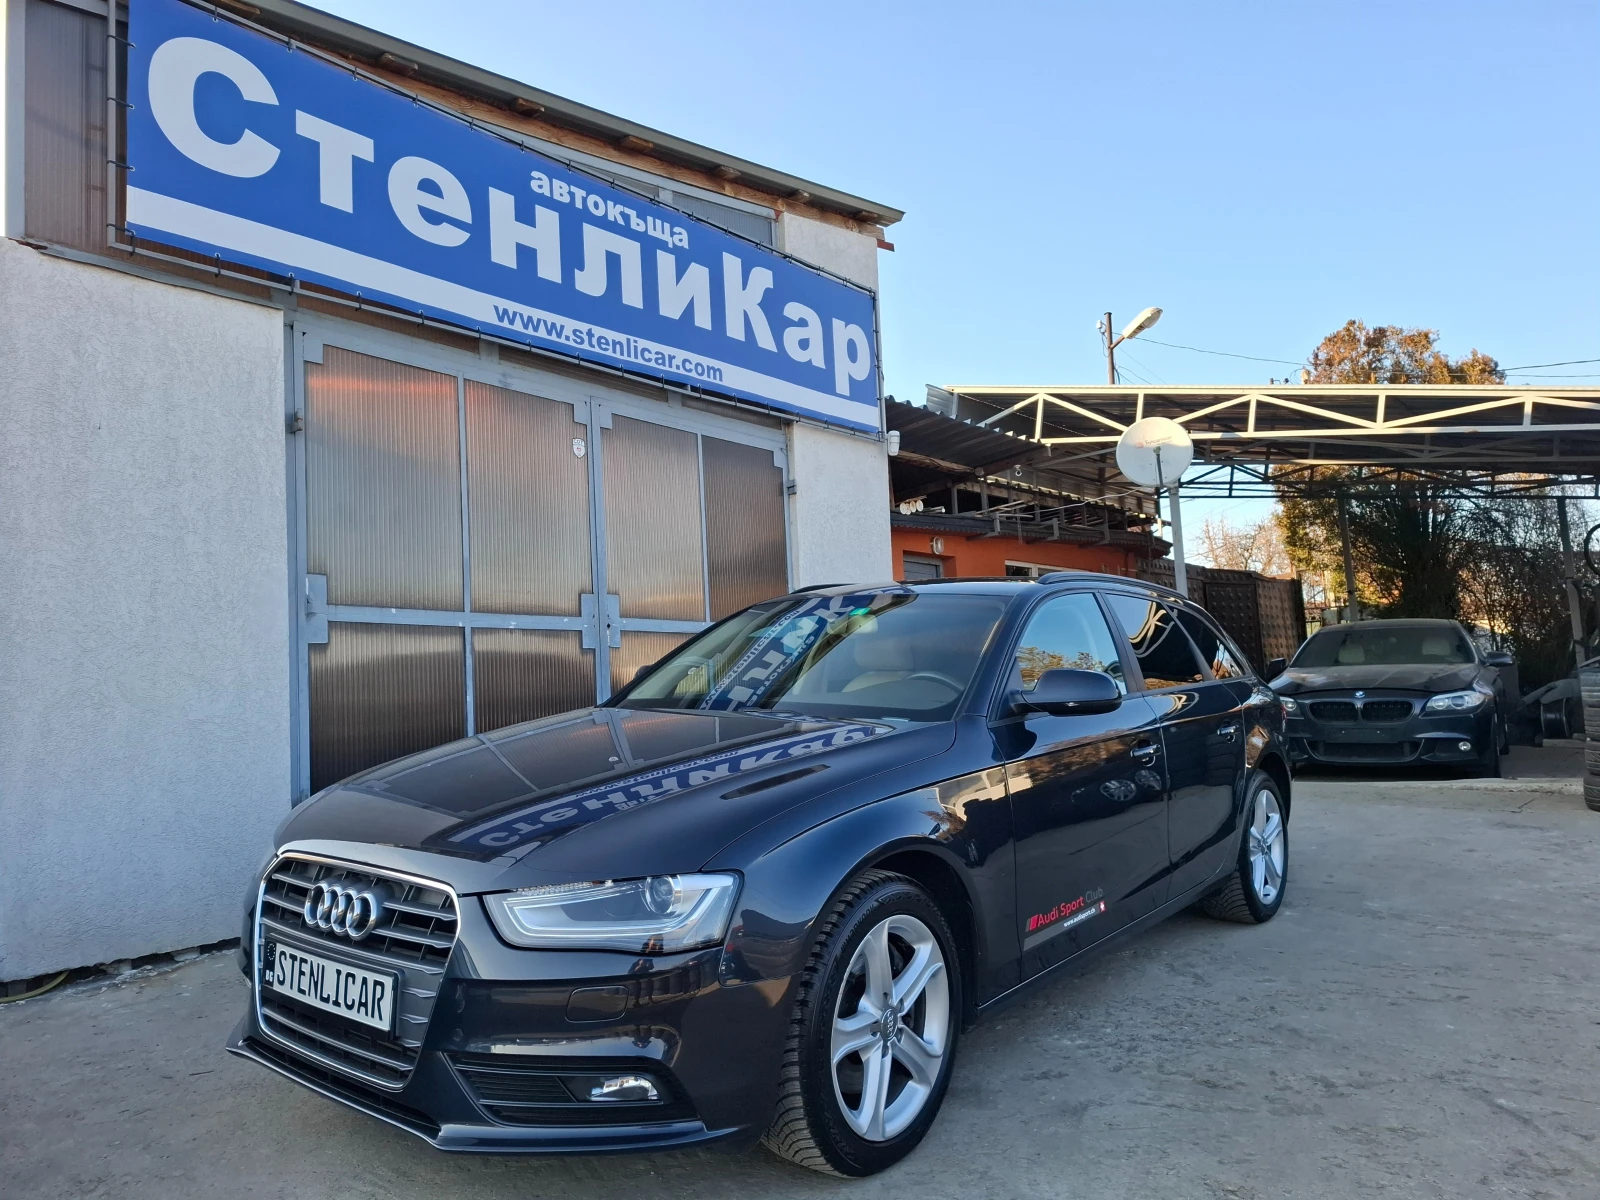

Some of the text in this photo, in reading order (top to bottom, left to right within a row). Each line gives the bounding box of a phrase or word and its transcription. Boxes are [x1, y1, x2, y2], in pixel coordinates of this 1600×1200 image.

[148, 37, 870, 396] СтенлиКар
[530, 170, 688, 249] автокъща
[494, 305, 723, 382] www.stenlicar.com
[1038, 887, 1104, 927] Audi Sport Club
[276, 950, 386, 1021] STENLICAR
